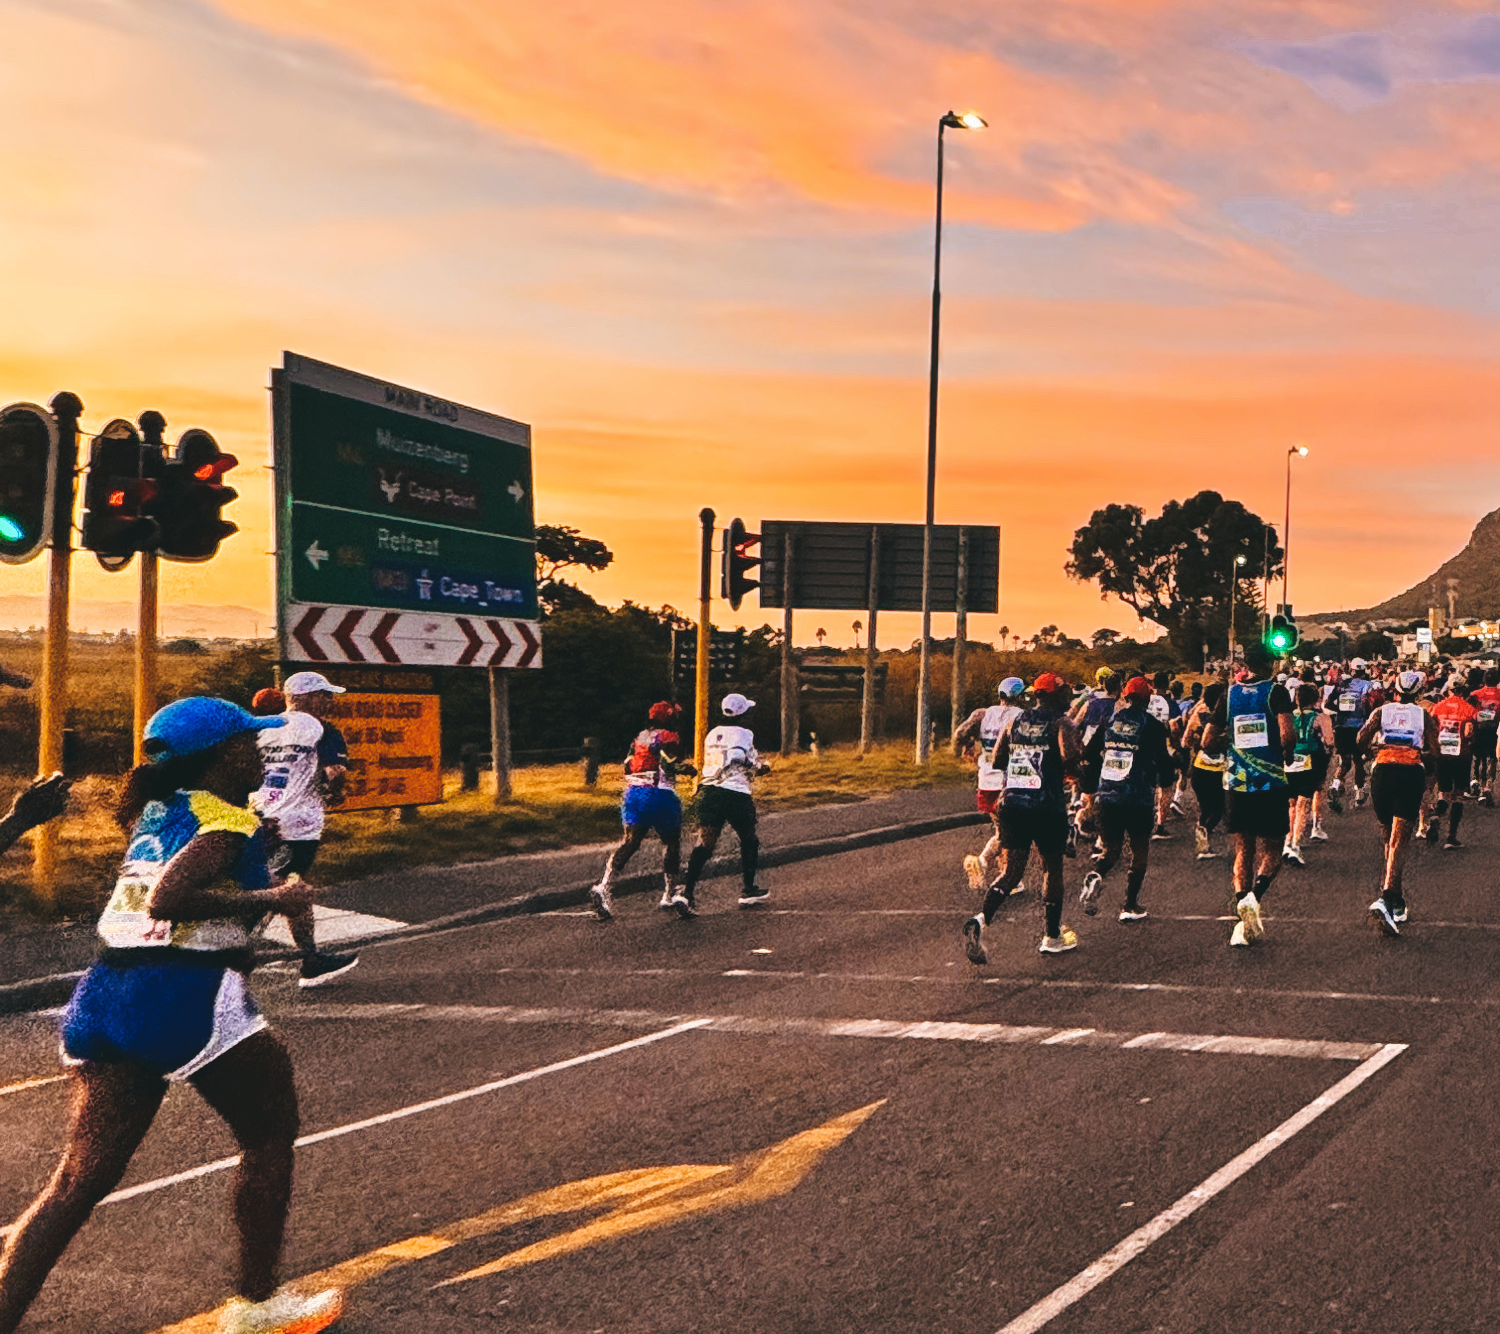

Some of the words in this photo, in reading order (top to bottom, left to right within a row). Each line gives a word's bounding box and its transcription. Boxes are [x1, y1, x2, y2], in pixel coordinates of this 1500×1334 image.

[376, 427, 469, 474] Muizenberg
[408, 480, 441, 505] Cape
[378, 527, 440, 556] Retreat
[440, 576, 480, 603] Cape
[484, 580, 524, 603] Town
